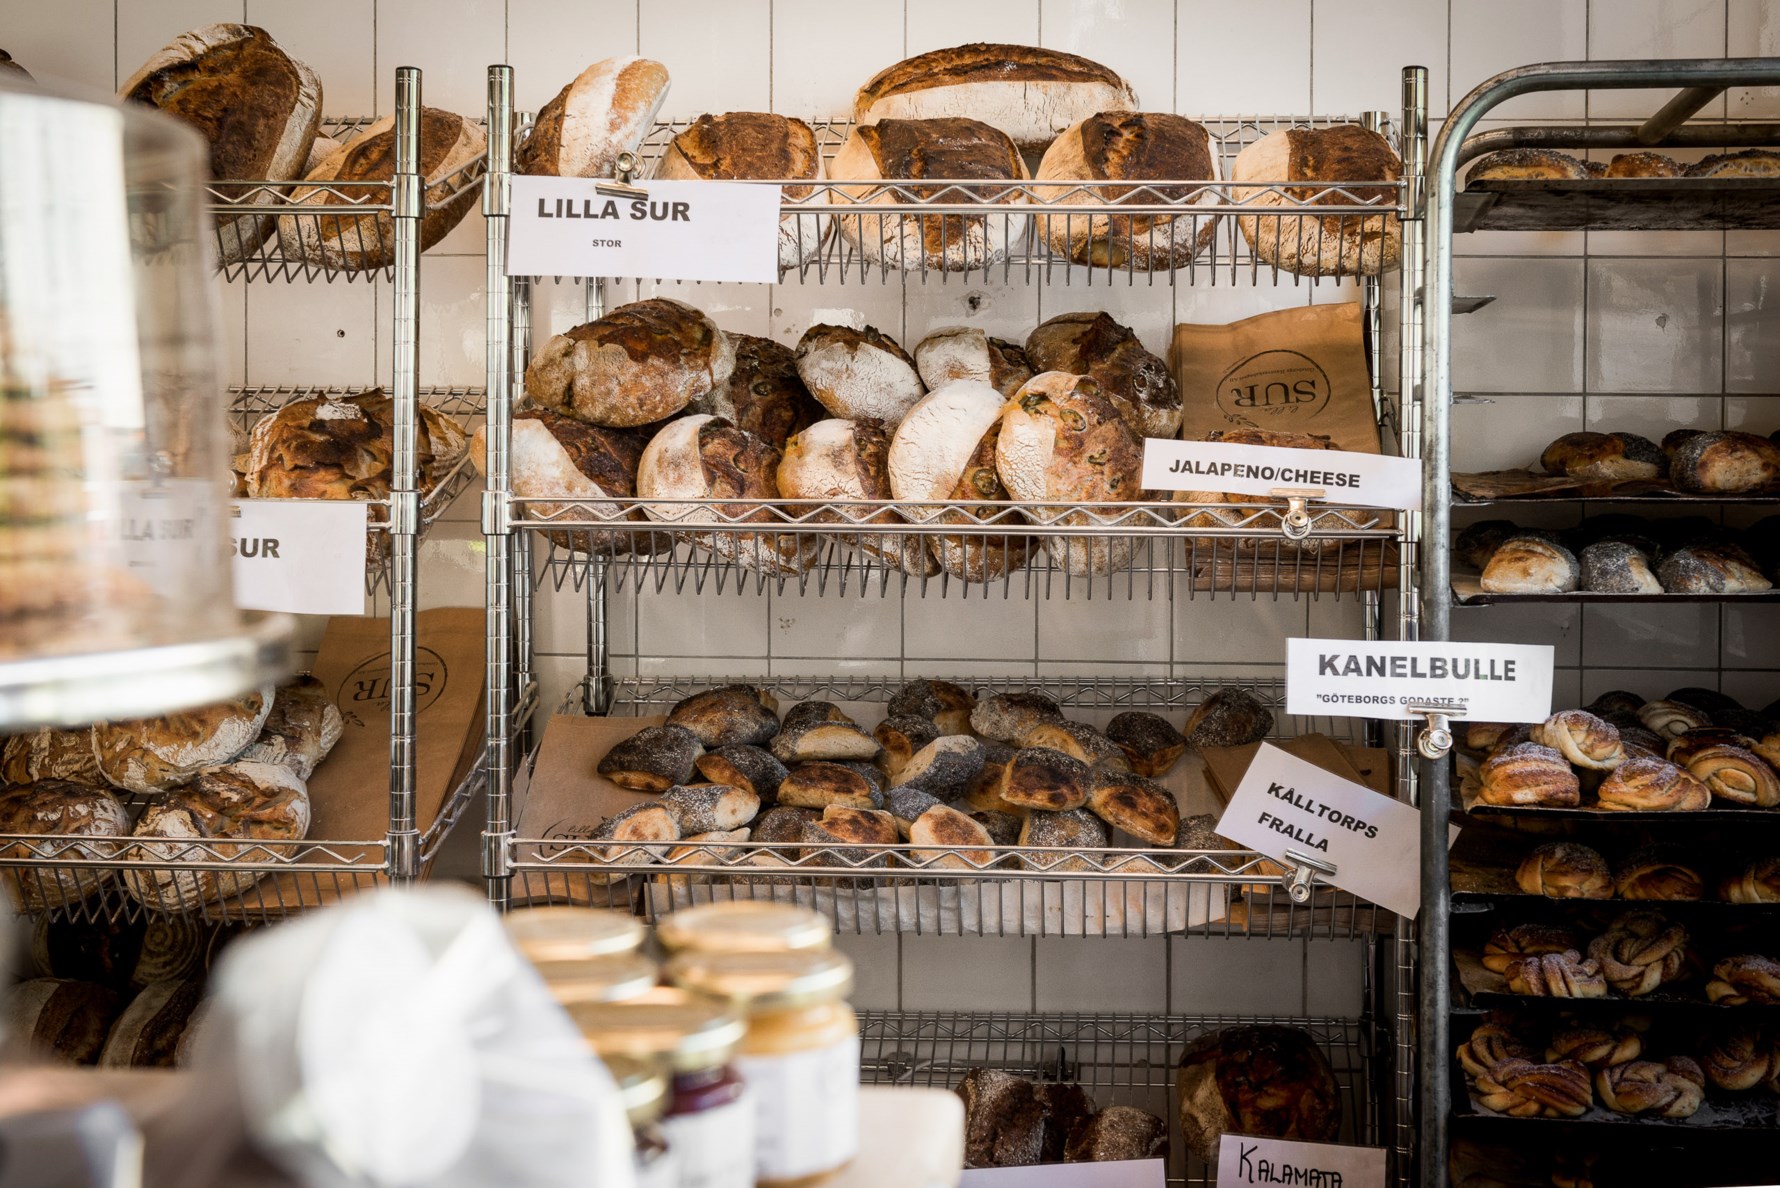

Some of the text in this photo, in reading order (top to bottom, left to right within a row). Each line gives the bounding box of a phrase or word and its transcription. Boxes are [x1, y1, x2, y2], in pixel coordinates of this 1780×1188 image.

[538, 198, 691, 222] LILLA SUR
[592, 239, 622, 248] STOR
[1230, 379, 1316, 408] SUR
[1169, 459, 1361, 488] JALAPENO/CHEESE
[1318, 653, 1516, 682] KANELBULLE
[1267, 781, 1379, 839] KÅLLTORPS
[1257, 811, 1329, 853] FRALLA
[1238, 1142, 1343, 1188] KALAMATA
